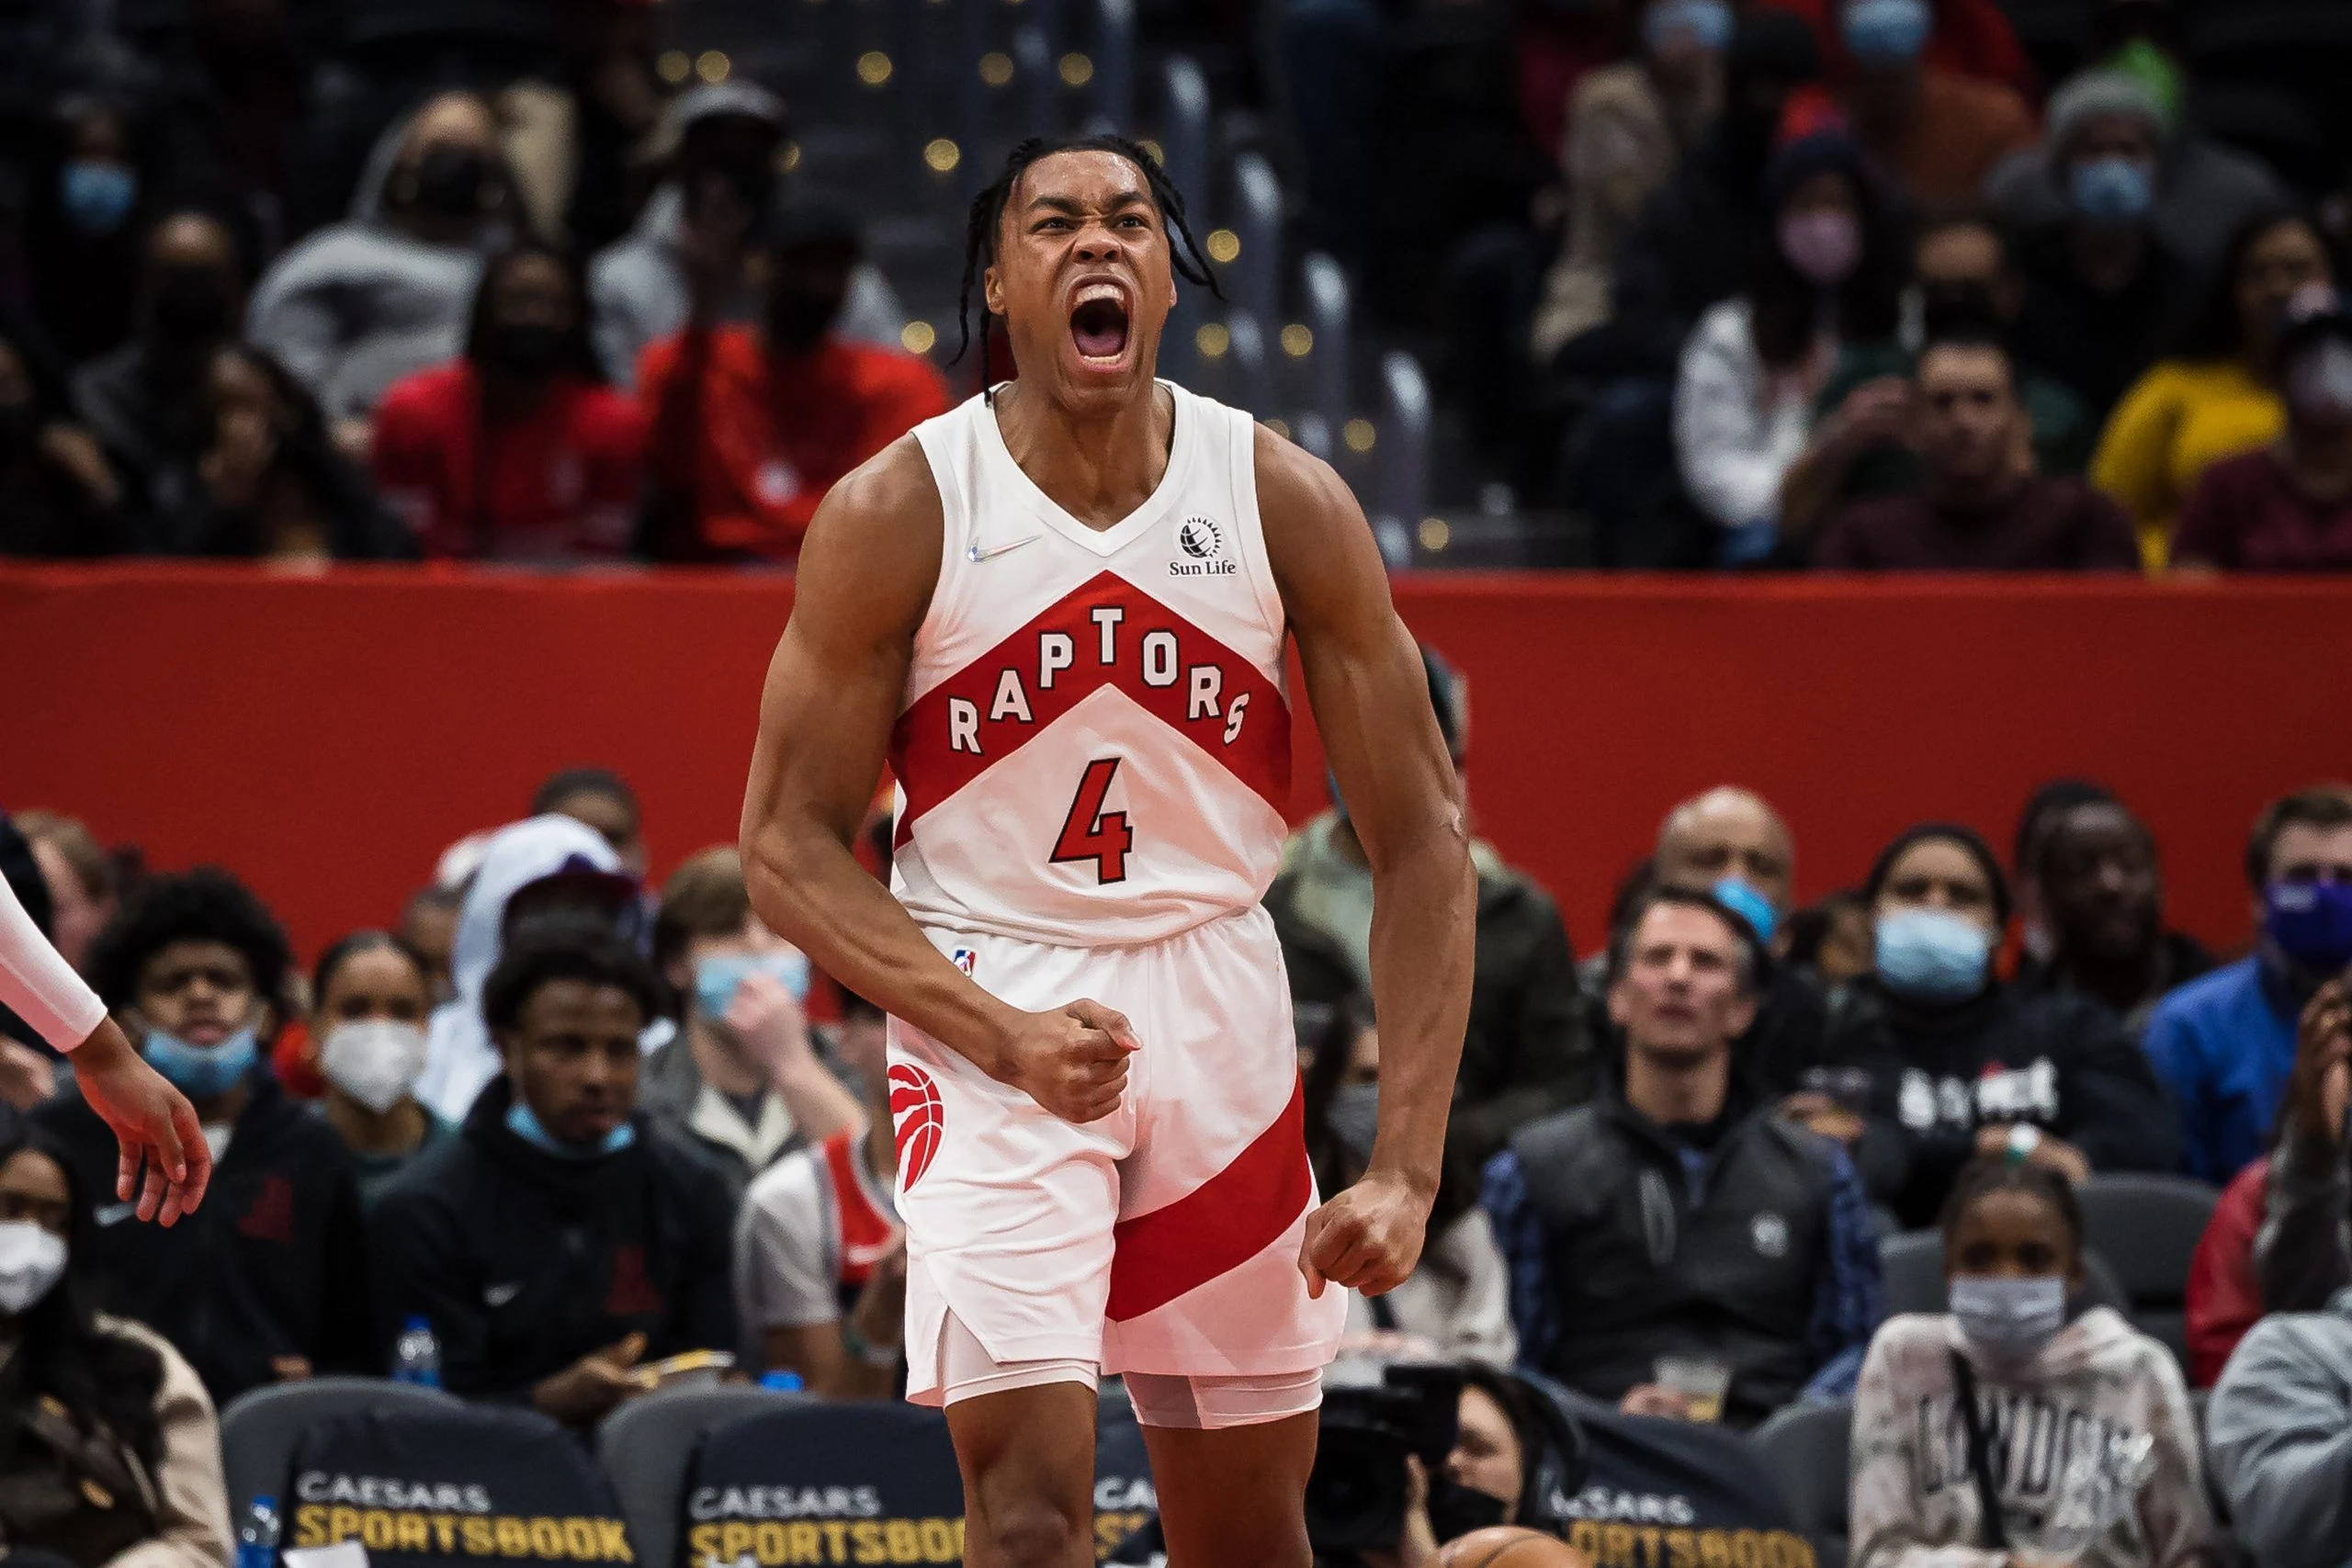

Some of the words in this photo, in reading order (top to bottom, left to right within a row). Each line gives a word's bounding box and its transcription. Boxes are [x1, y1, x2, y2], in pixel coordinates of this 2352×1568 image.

[1170, 561, 1202, 576] Sun
[1205, 559, 1237, 575] Life
[949, 606, 1250, 755] RAPTORS
[1048, 757, 1133, 885] 4
[297, 1471, 492, 1513] CAESARS
[690, 1485, 880, 1518] CAESARS
[295, 1505, 634, 1563] SPORTSBOOK
[690, 1517, 966, 1565] SPORTSBO
